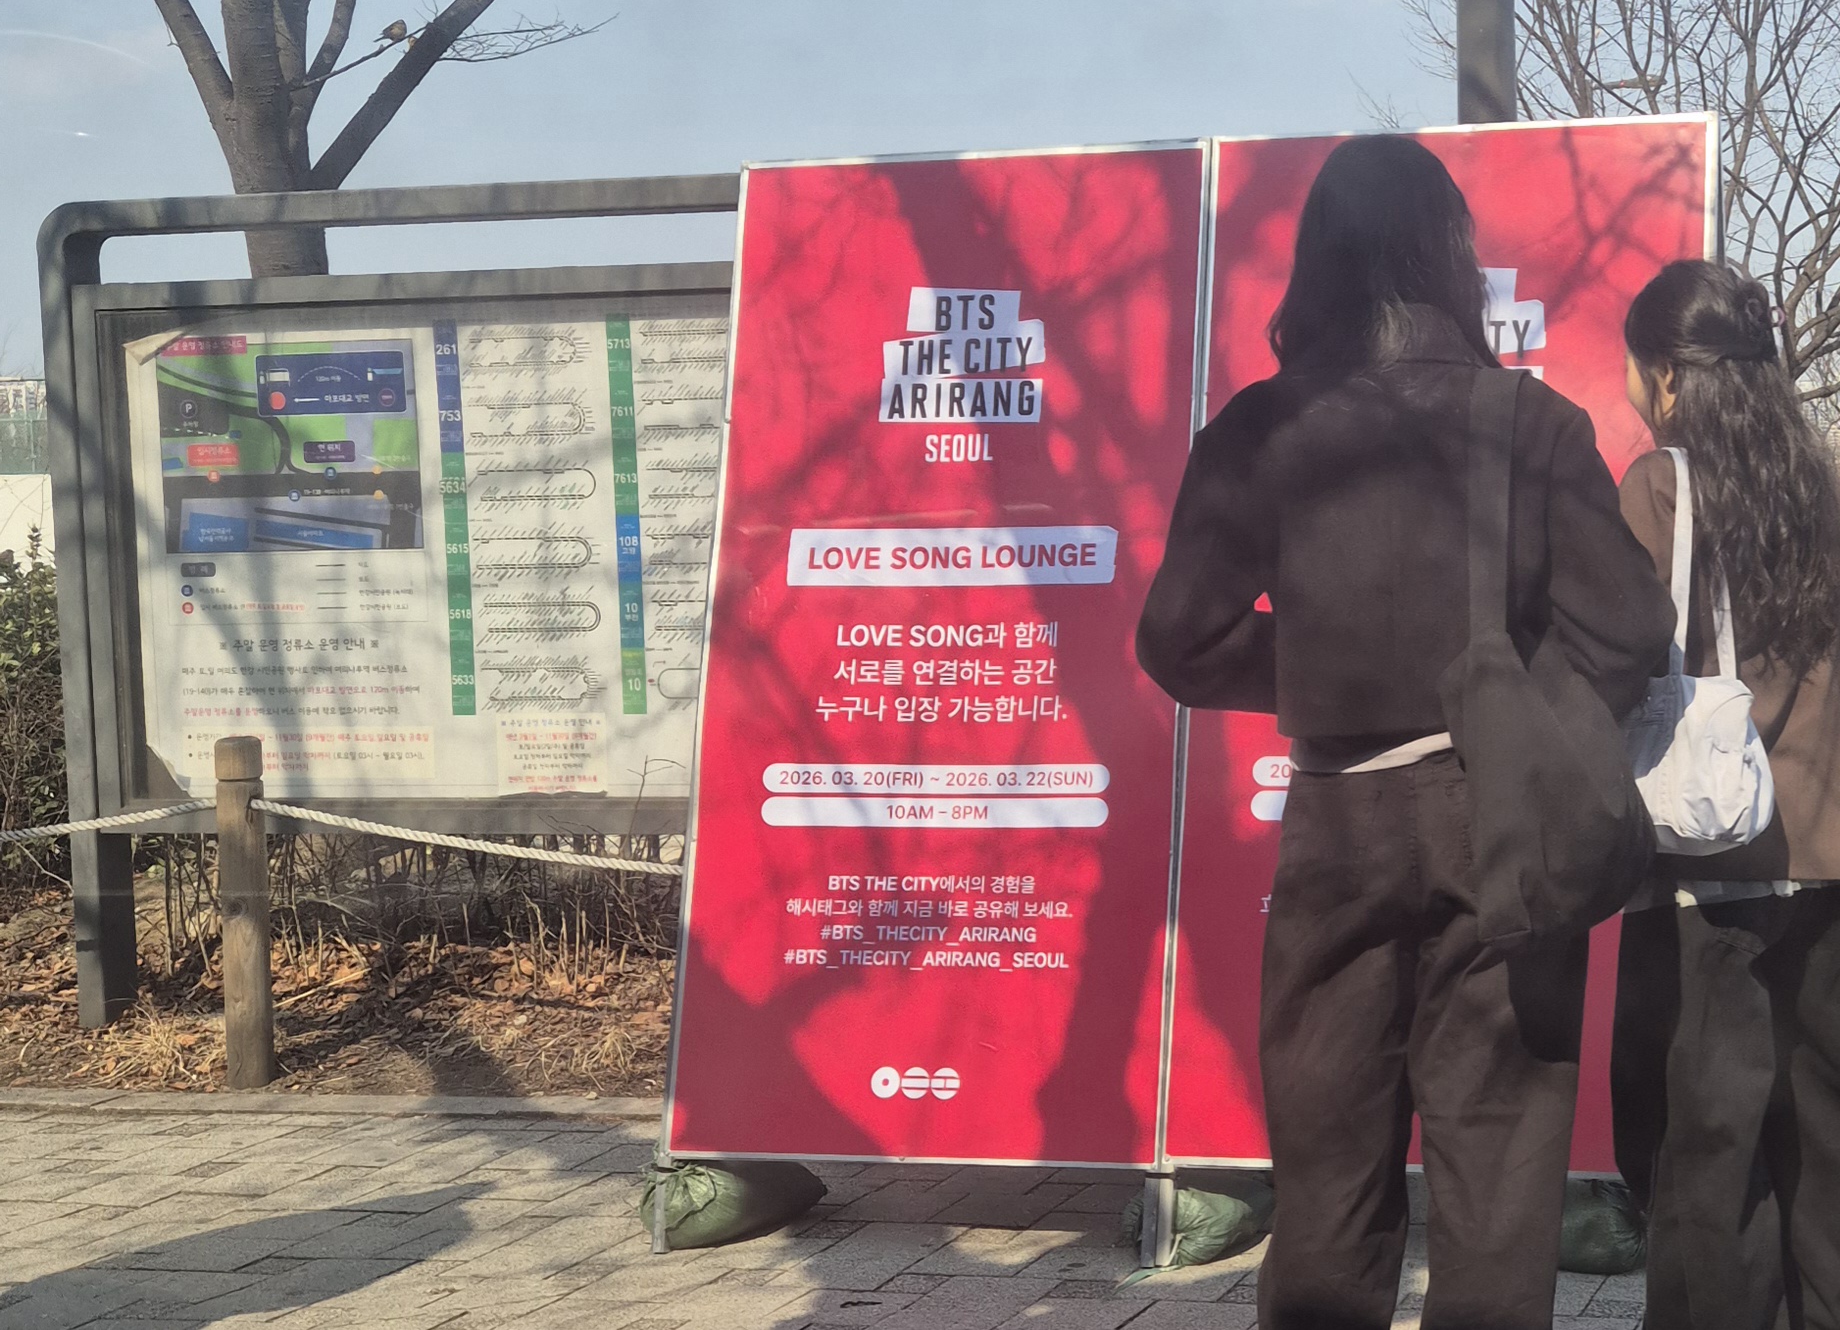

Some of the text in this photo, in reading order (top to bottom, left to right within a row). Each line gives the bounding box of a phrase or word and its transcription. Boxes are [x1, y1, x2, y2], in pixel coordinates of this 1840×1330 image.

[935, 294, 995, 331] BTS
[607, 339, 630, 350] 5713
[1489, 320, 1531, 359] TY
[435, 344, 457, 355] 261
[899, 337, 1033, 376] THE CITY
[888, 381, 1034, 419] ARIRANG
[185, 403, 193, 413] P
[611, 406, 634, 417] 7611
[439, 410, 461, 421] 753
[925, 434, 993, 463] SEOUL
[615, 473, 637, 484] 7613
[439, 481, 465, 494] 5634
[618, 536, 638, 546] 108
[447, 543, 469, 554] 5615
[808, 543, 1097, 569] LOVE SONG LOUNGE
[449, 609, 471, 619] 5618
[624, 602, 638, 613] 10
[836, 621, 1058, 648] LOVE SONG과 함께
[233, 638, 365, 652] 주말 운영 정류소 운영 안내
[452, 674, 474, 685] 5633
[833, 659, 1057, 686] 서로를 연결하는 공간
[628, 677, 641, 691] 10
[815, 695, 1068, 722] 누구나 입장 가능합니다.
[779, 771, 827, 785] 2026.
[831, 771, 858, 785] 03.
[863, 771, 924, 788] 20(FRI)
[945, 772, 992, 787] 2026.
[996, 772, 1022, 787] 03.
[1026, 771, 1093, 788] 22(SUN)
[887, 805, 934, 820] 10AM
[951, 805, 988, 820] 8PM
[828, 875, 1036, 893] BTS THE CITY에서의 경험을
[786, 899, 1073, 918] 해시태그와 함께 지금 바로 공유해 보세요.
